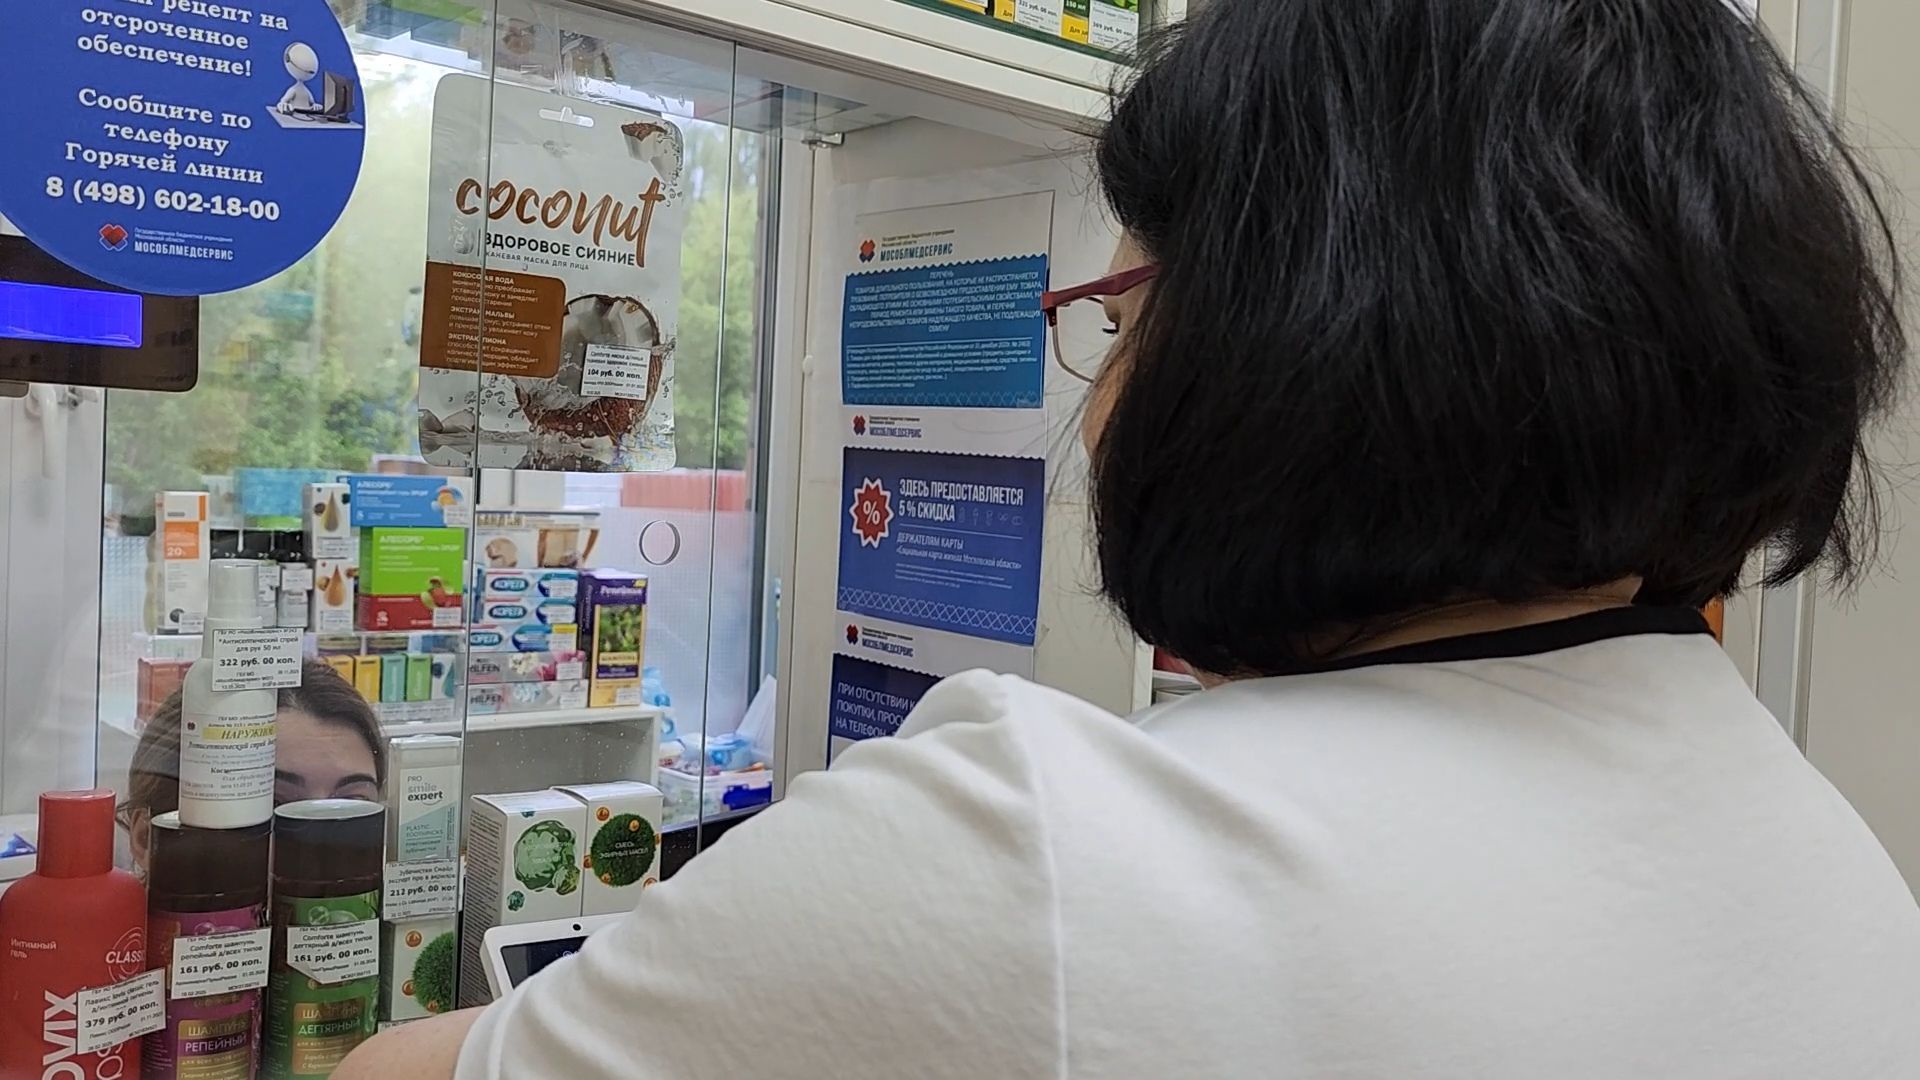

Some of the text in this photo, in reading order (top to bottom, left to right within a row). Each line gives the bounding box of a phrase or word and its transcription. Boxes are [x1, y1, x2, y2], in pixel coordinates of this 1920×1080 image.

[162, 0, 289, 30] рецепт на
[81, 8, 249, 49] отсроченное
[77, 34, 251, 77] обеспечение!
[78, 88, 251, 128] Сообщите по
[104, 122, 229, 155] телефону
[65, 142, 263, 184] Горячей линии
[46, 177, 280, 220] 8 (498) 602-18-00
[456, 177, 666, 268] coconut
[134, 241, 234, 260] МОСОБЛМЕДСЕРВИС
[486, 232, 570, 256] ЗДОРОВОЕ
[576, 246, 635, 266] СИЯНИЕ
[486, 251, 521, 261] КАНЕВАЯ
[524, 256, 549, 265] МАСКА
[880, 243, 953, 261] МОСОБЛМЕДСЕРВИС
[453, 271, 514, 284] КОКОСОАЯ ВОДА
[588, 368, 599, 376] 104
[600, 370, 614, 378] руб.
[899, 478, 1023, 506] ЗДЕСЬ ПРЕДОСТАВЛЯЕТСЯ
[899, 500, 955, 522] 5 % СКИДКА
[897, 532, 963, 550] ДЕРЖАТЕЛЯМ КАРТЫ
[220, 658, 238, 667] 322
[241, 657, 260, 667] руб.
[263, 657, 274, 665] 00
[837, 682, 855, 696] ПРИ
[855, 687, 909, 711] ОТСУТСТВИИ
[836, 699, 876, 721] ПОКУПКИ,
[835, 717, 848, 728] НА
[407, 790, 443, 802] expert
[408, 782, 437, 793] smile
[390, 885, 406, 897] 212
[407, 885, 426, 896] руб.
[428, 884, 439, 892] 00
[10, 938, 57, 950] Интимный
[190, 943, 223, 952] Comforte
[10, 950, 28, 959] гель
[294, 948, 372, 963] 161 руб. 00 коп.
[180, 958, 262, 975] 161 руб. 00 коп.
[85, 1001, 159, 1029] 379 руб. 00 коп.
[188, 1021, 246, 1037] ШАМПУНЬ
[298, 1017, 361, 1036] ДЕГТЯРНЫЙ
[185, 1032, 247, 1053] РЕПЕЙНЫЙ
